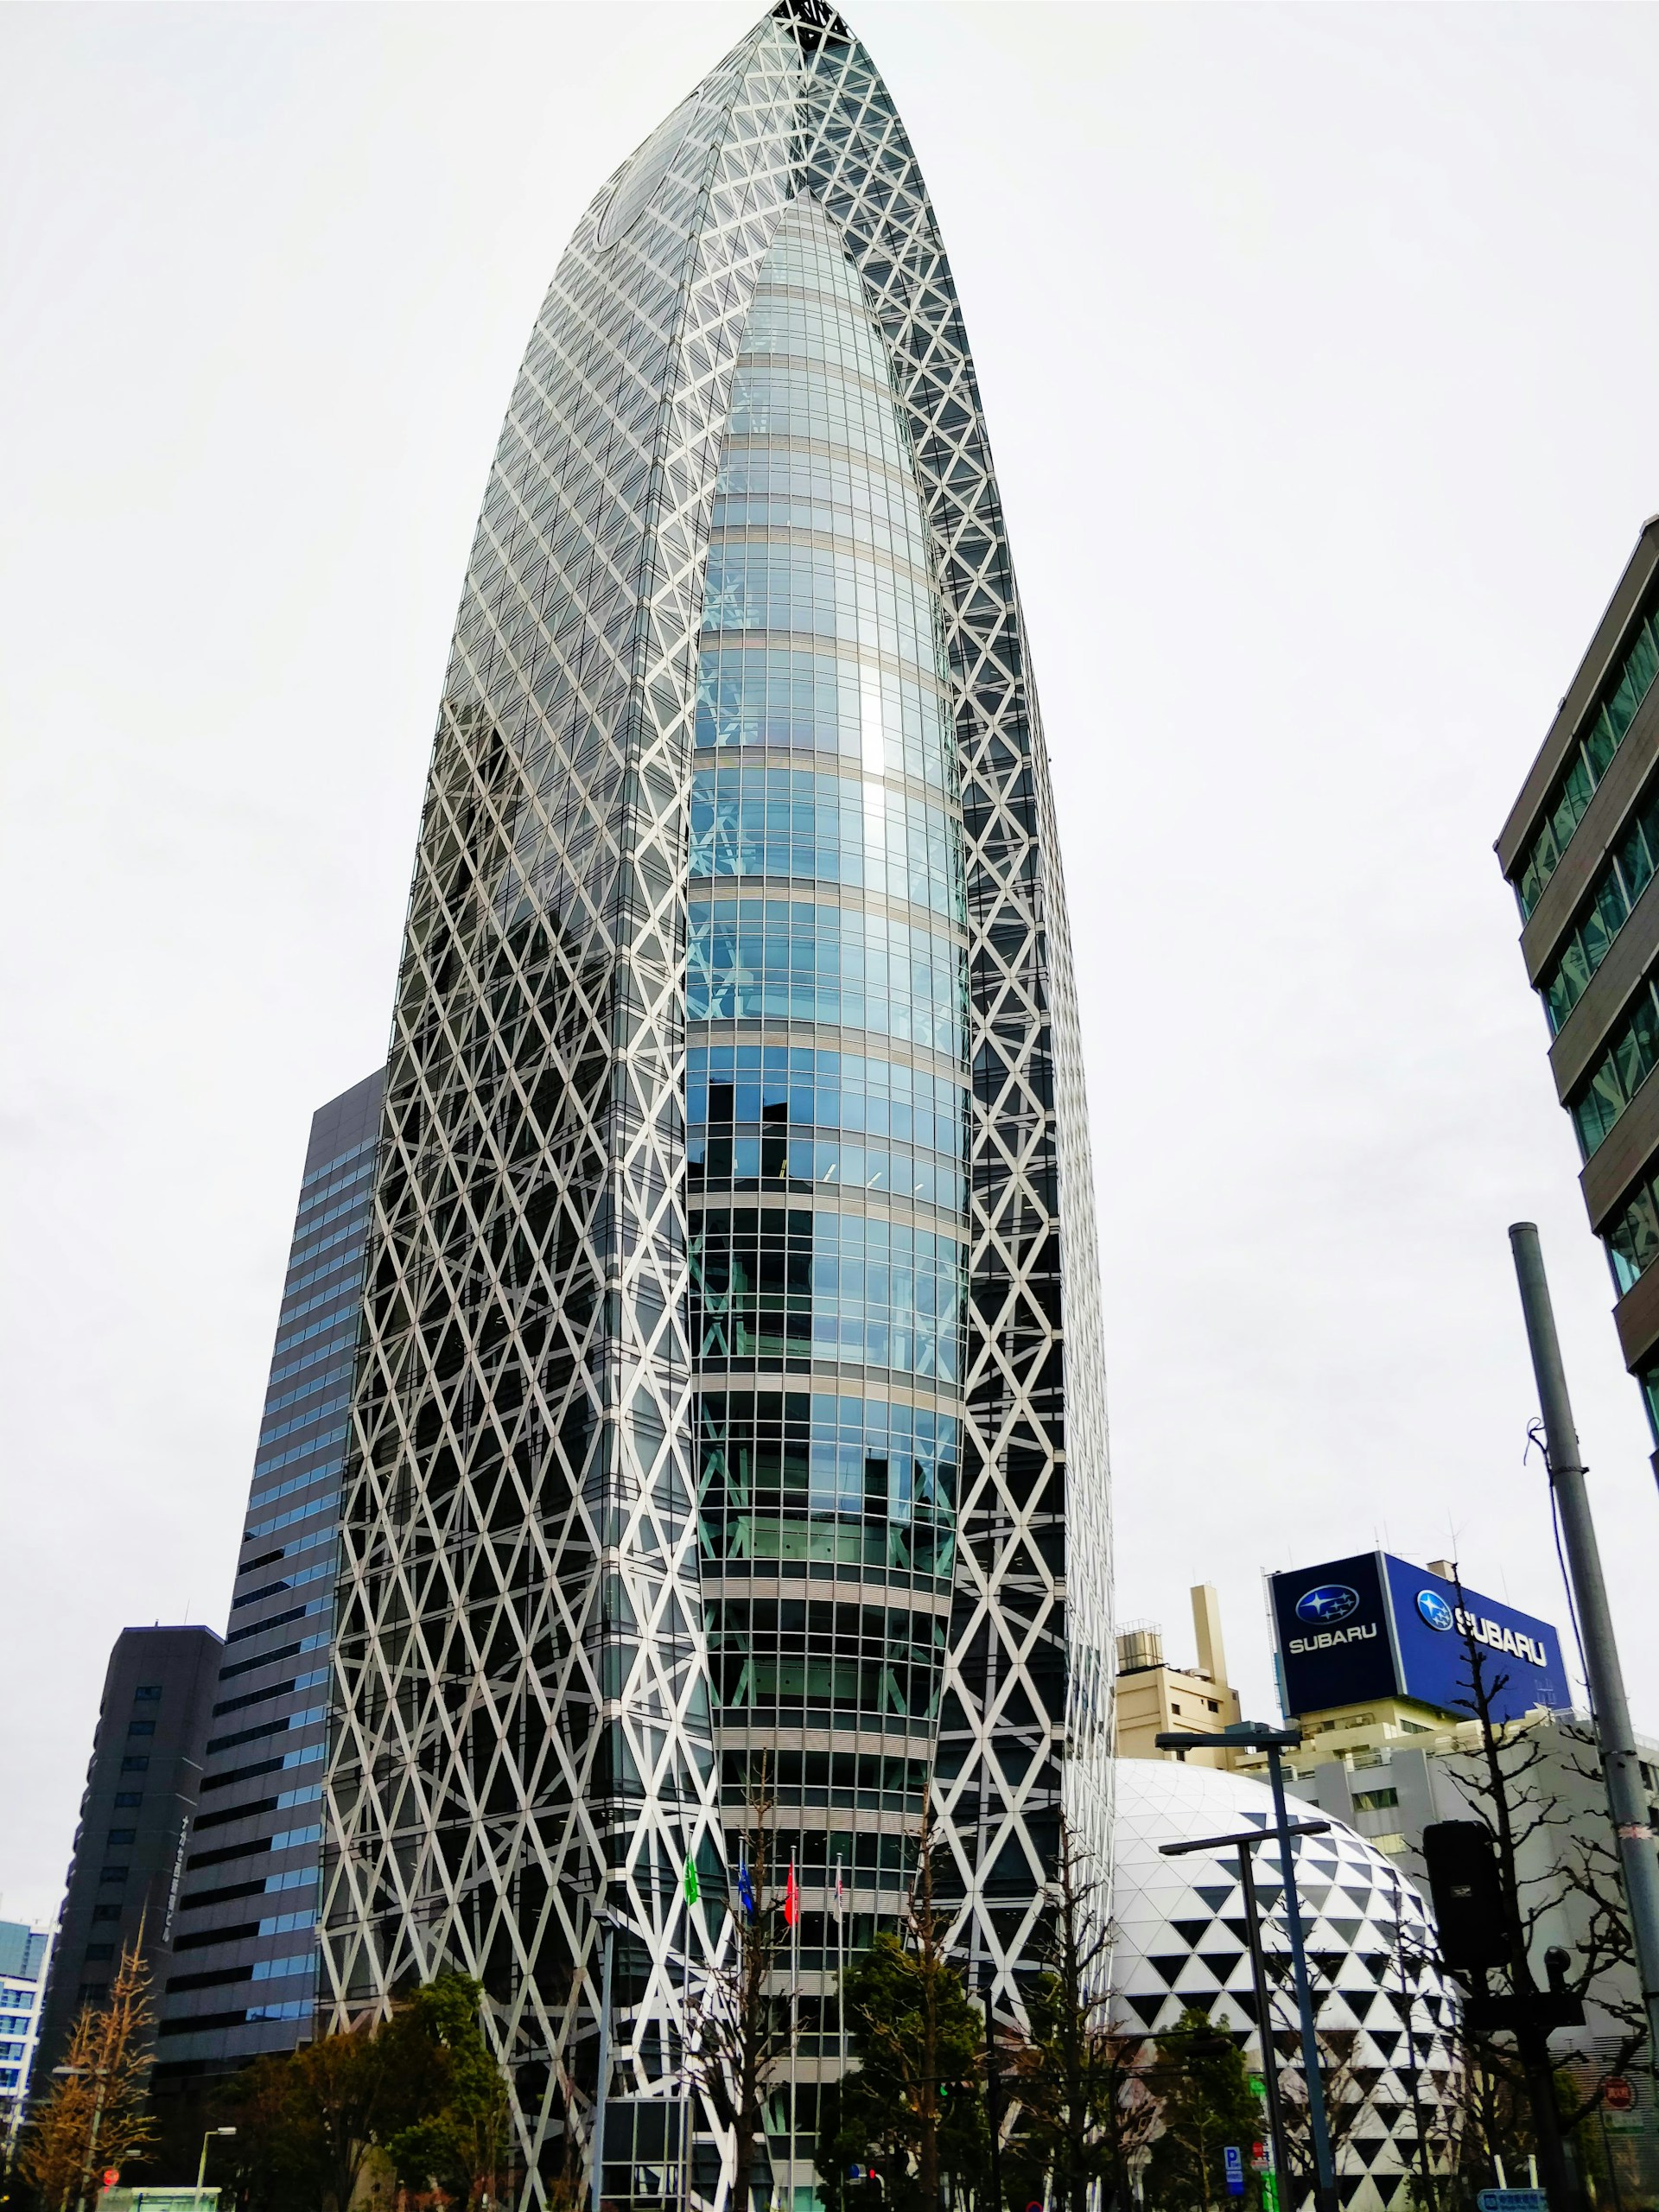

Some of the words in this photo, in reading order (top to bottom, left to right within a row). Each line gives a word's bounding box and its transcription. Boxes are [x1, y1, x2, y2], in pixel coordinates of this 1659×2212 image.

[1288, 1623, 1377, 1654] SUBARU
[1454, 1607, 1548, 1668] SUBARU
[1226, 2149, 1237, 2168] P
